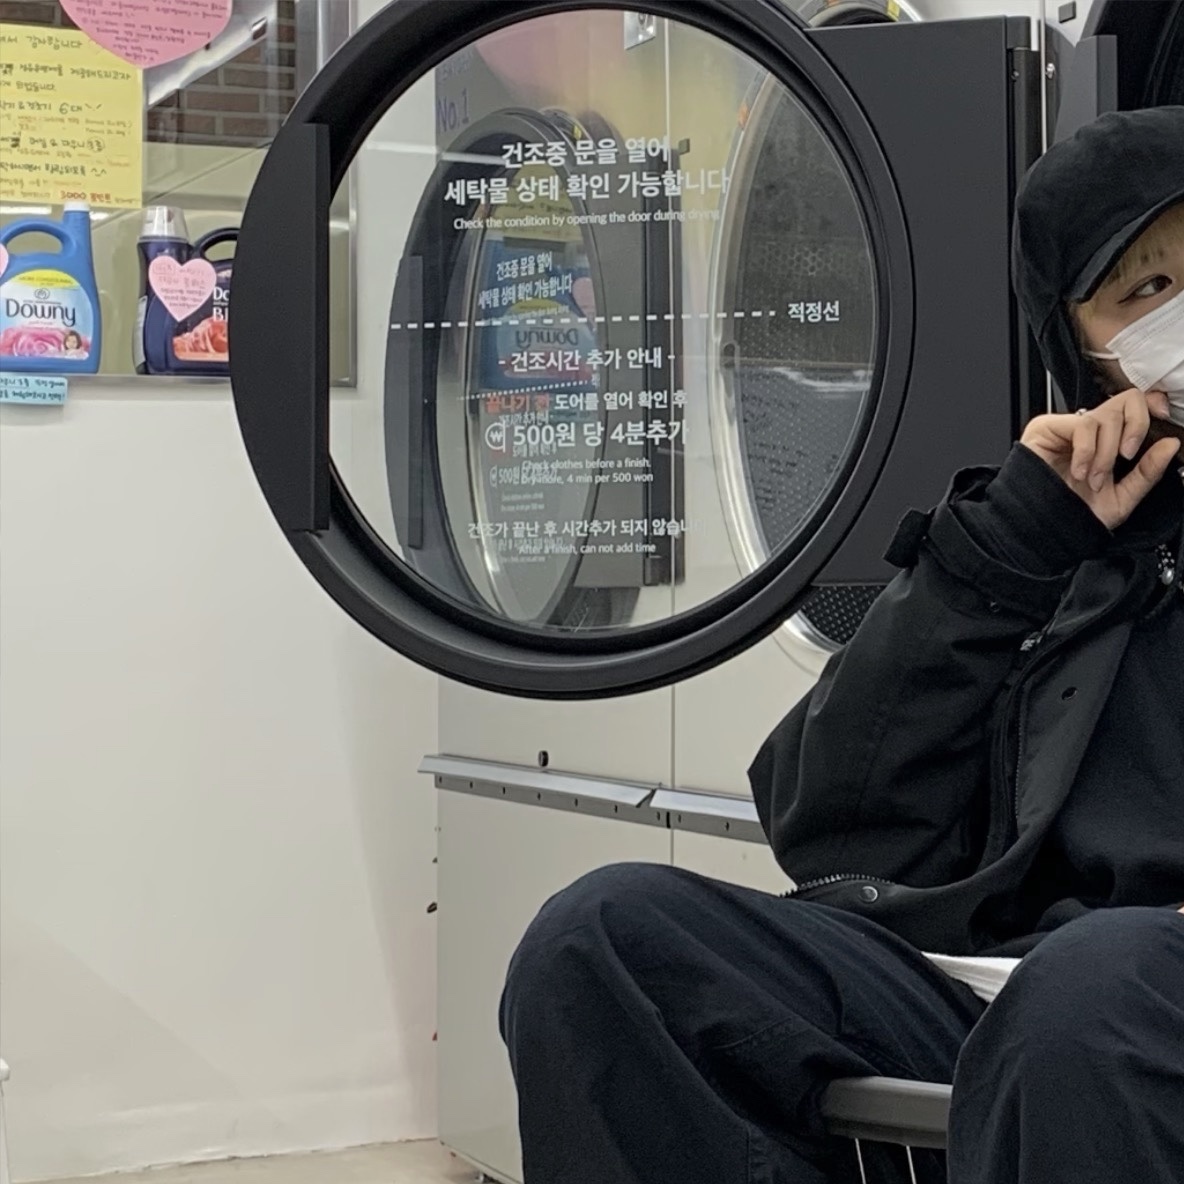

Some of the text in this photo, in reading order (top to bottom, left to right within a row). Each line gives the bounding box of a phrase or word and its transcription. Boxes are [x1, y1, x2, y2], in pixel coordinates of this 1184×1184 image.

[502, 135, 669, 169] 건조중 문을 열어
[444, 168, 731, 206] 세탁물 상태 확인 가능합니다
[453, 217, 484, 230] Check
[485, 215, 502, 228] the
[504, 214, 550, 227] condition
[552, 213, 564, 226] by
[567, 212, 607, 226] opening
[609, 211, 626, 222] the
[628, 211, 652, 223] door
[653, 209, 685, 222] during
[534, 272, 572, 298] 가능합니다
[6, 298, 77, 328] Downy
[788, 300, 840, 323] 적정선
[511, 346, 662, 373] 건조시간 추가 안내
[554, 392, 600, 412] 도어를
[603, 391, 634, 411] 열어
[638, 389, 668, 410] 확인
[673, 389, 688, 409] 후
[513, 420, 688, 447] 500원 당 4분추가
[550, 459, 583, 470] clothes
[585, 457, 614, 469] before
[567, 474, 574, 483] 4
[575, 473, 592, 483] min
[594, 474, 610, 485] per
[612, 472, 631, 483] 500
[633, 474, 653, 483] won
[467, 521, 509, 539] 건조가
[512, 520, 539, 538] 끝난
[543, 520, 558, 537] 후
[561, 519, 617, 538] 시간추가
[620, 519, 648, 537] 되지
[518, 544, 544, 555] After
[580, 546, 596, 554] can
[598, 544, 613, 554] not
[615, 543, 632, 553] add
[634, 542, 656, 553] time
